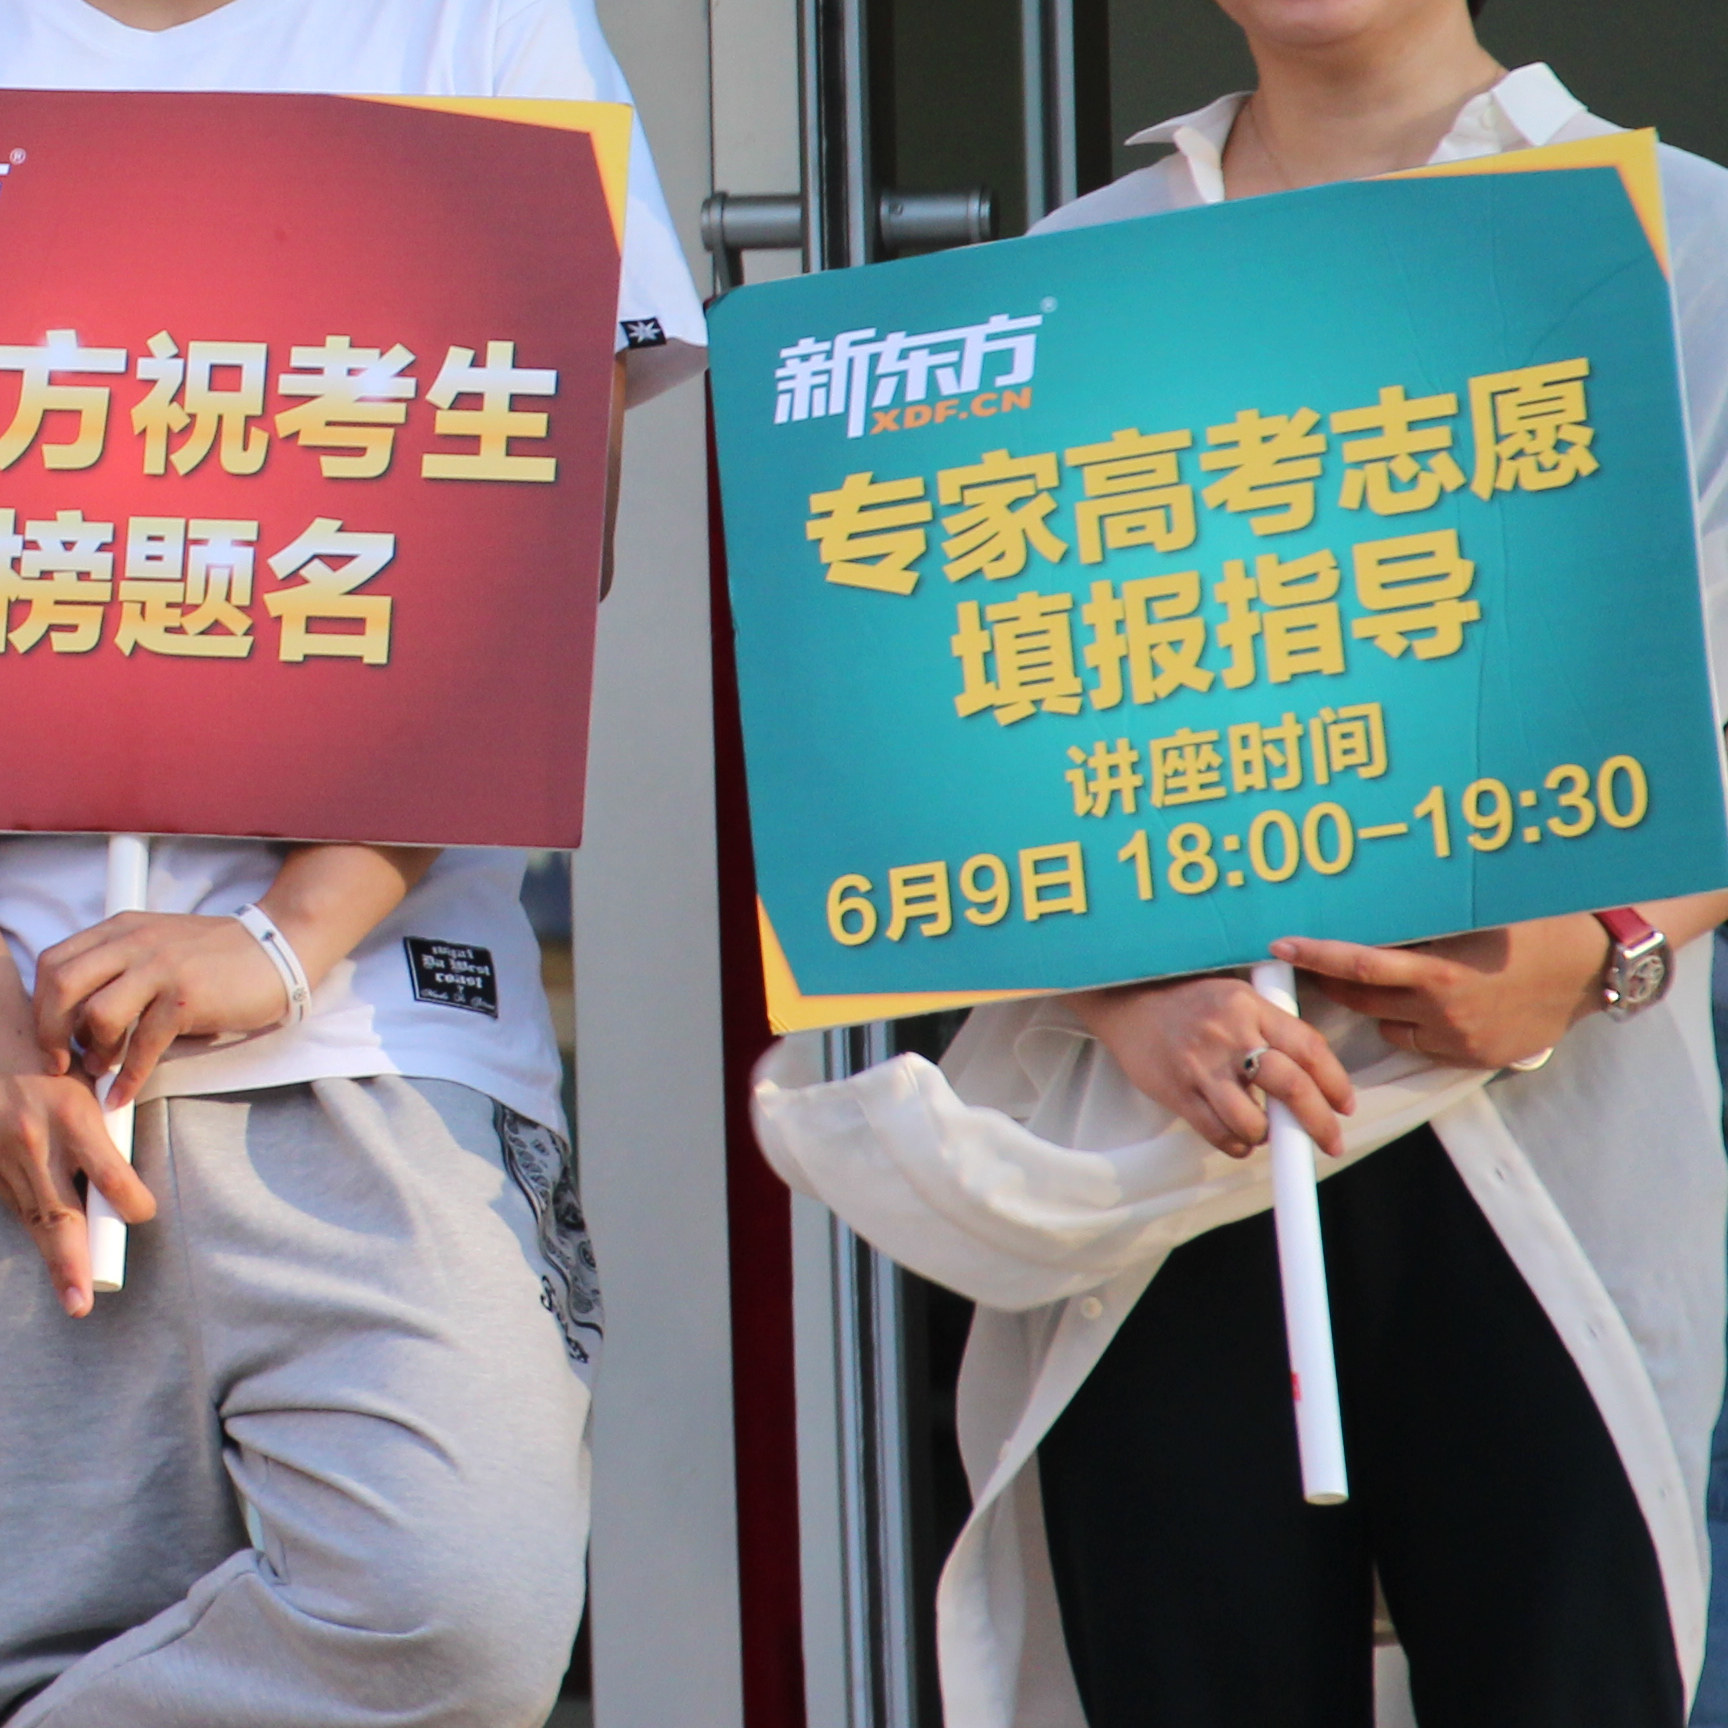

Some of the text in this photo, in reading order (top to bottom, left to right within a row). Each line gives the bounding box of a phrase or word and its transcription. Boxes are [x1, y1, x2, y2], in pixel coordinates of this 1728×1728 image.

[773, 312, 1044, 438] 新东方
[869, 386, 1032, 436] XDF.CN
[805, 357, 1599, 597] 专家高考志愿
[950, 529, 1481, 728] 填报指导
[1065, 702, 1389, 820] 讲座时间
[825, 754, 1649, 947] 6月9日 18:00-19:30
